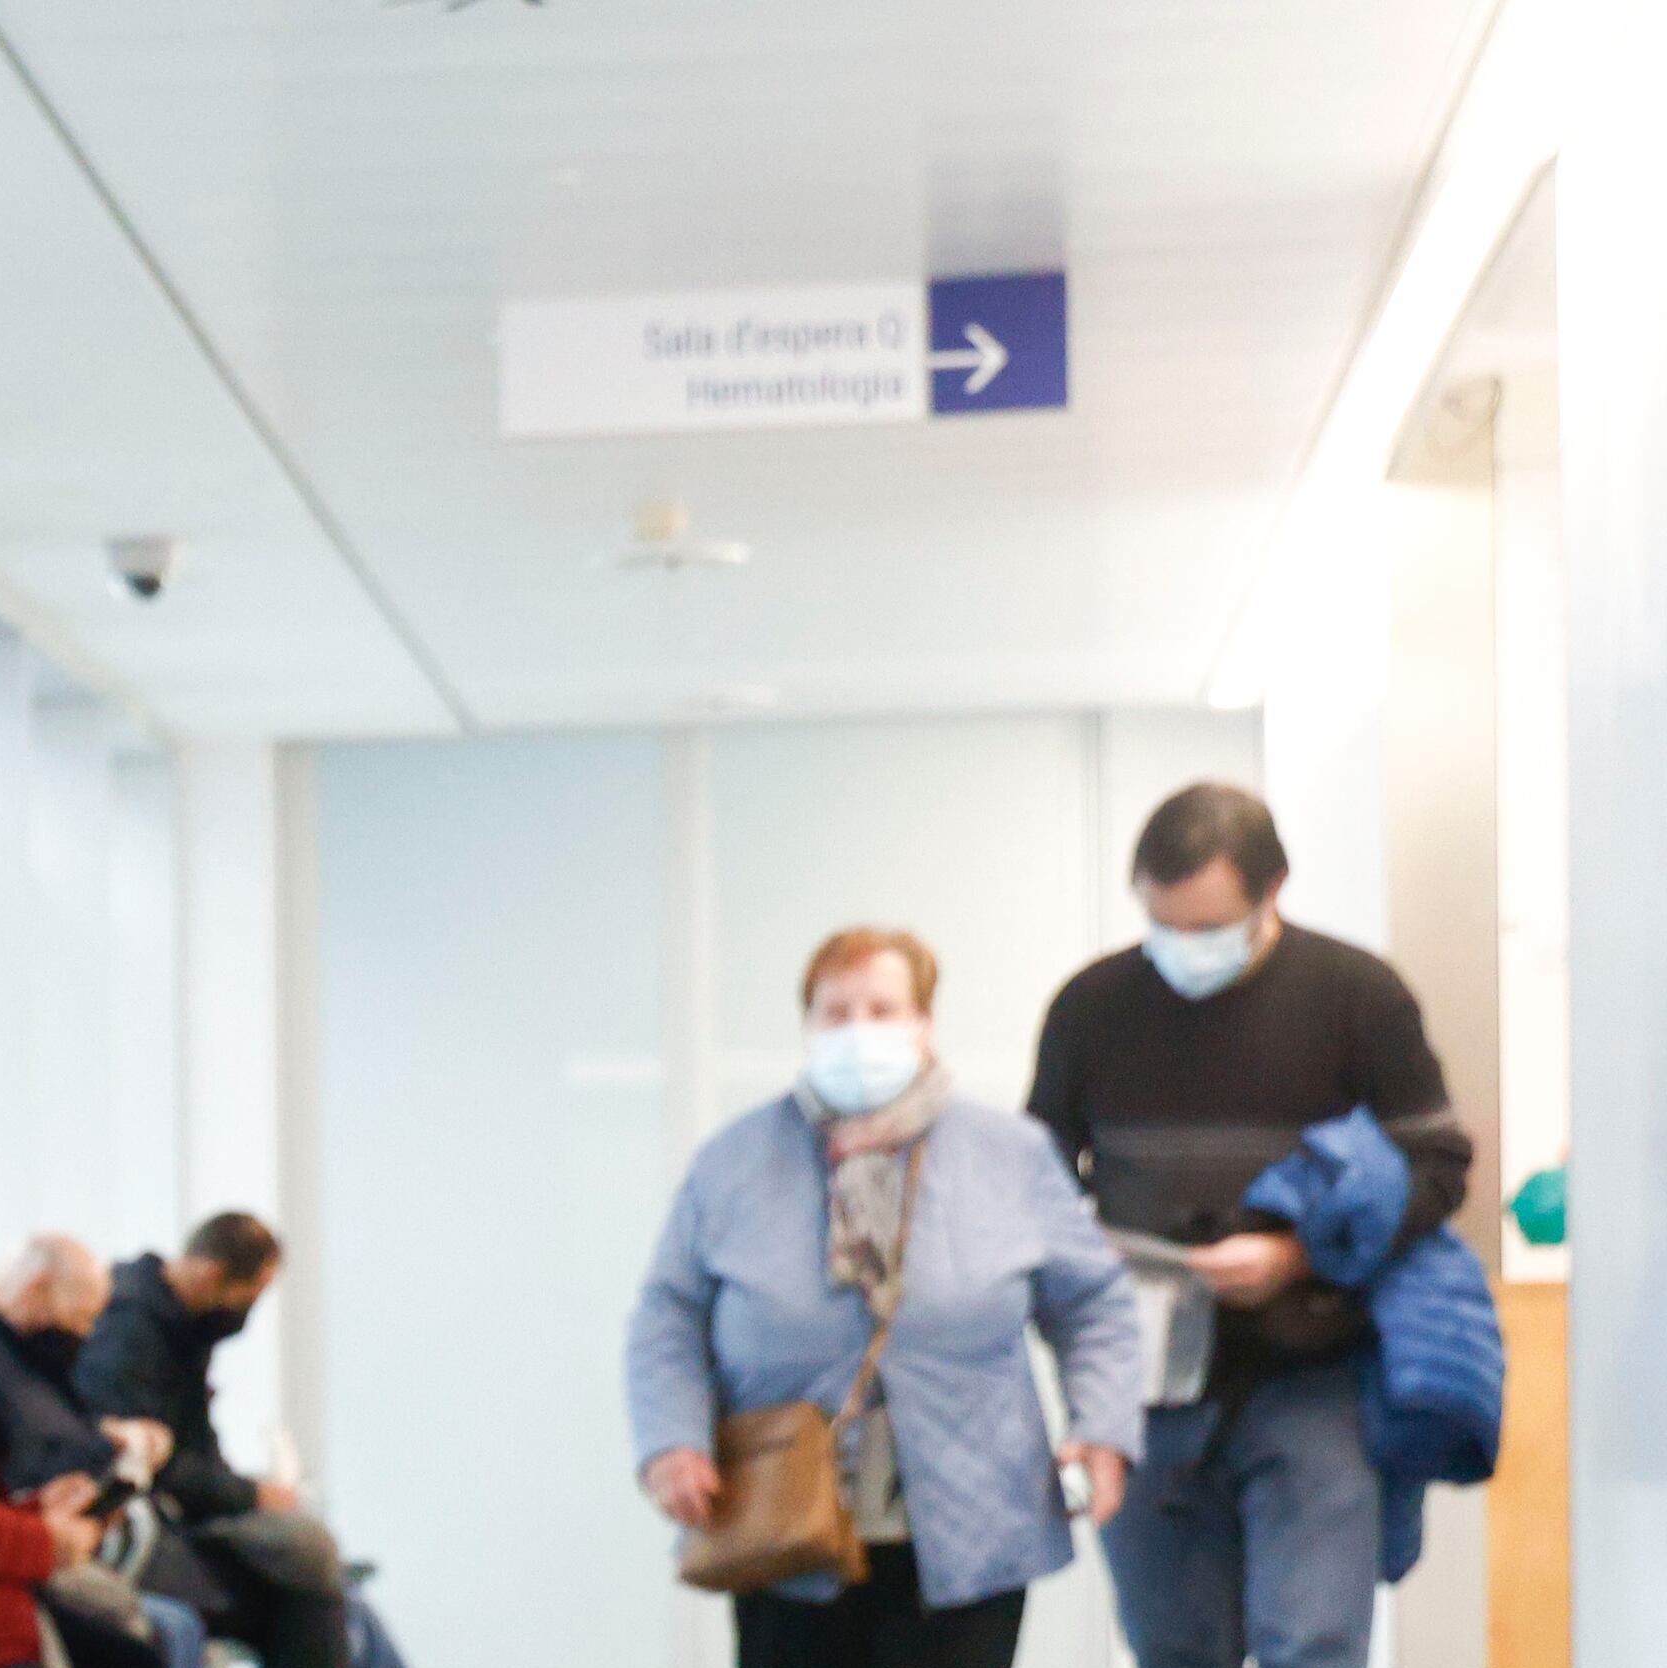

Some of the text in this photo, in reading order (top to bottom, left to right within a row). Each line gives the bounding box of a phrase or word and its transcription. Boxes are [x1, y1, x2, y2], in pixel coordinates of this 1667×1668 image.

[643, 318, 714, 359] Sala
[724, 312, 867, 358] d'espera
[685, 367, 904, 412] Hematologia
